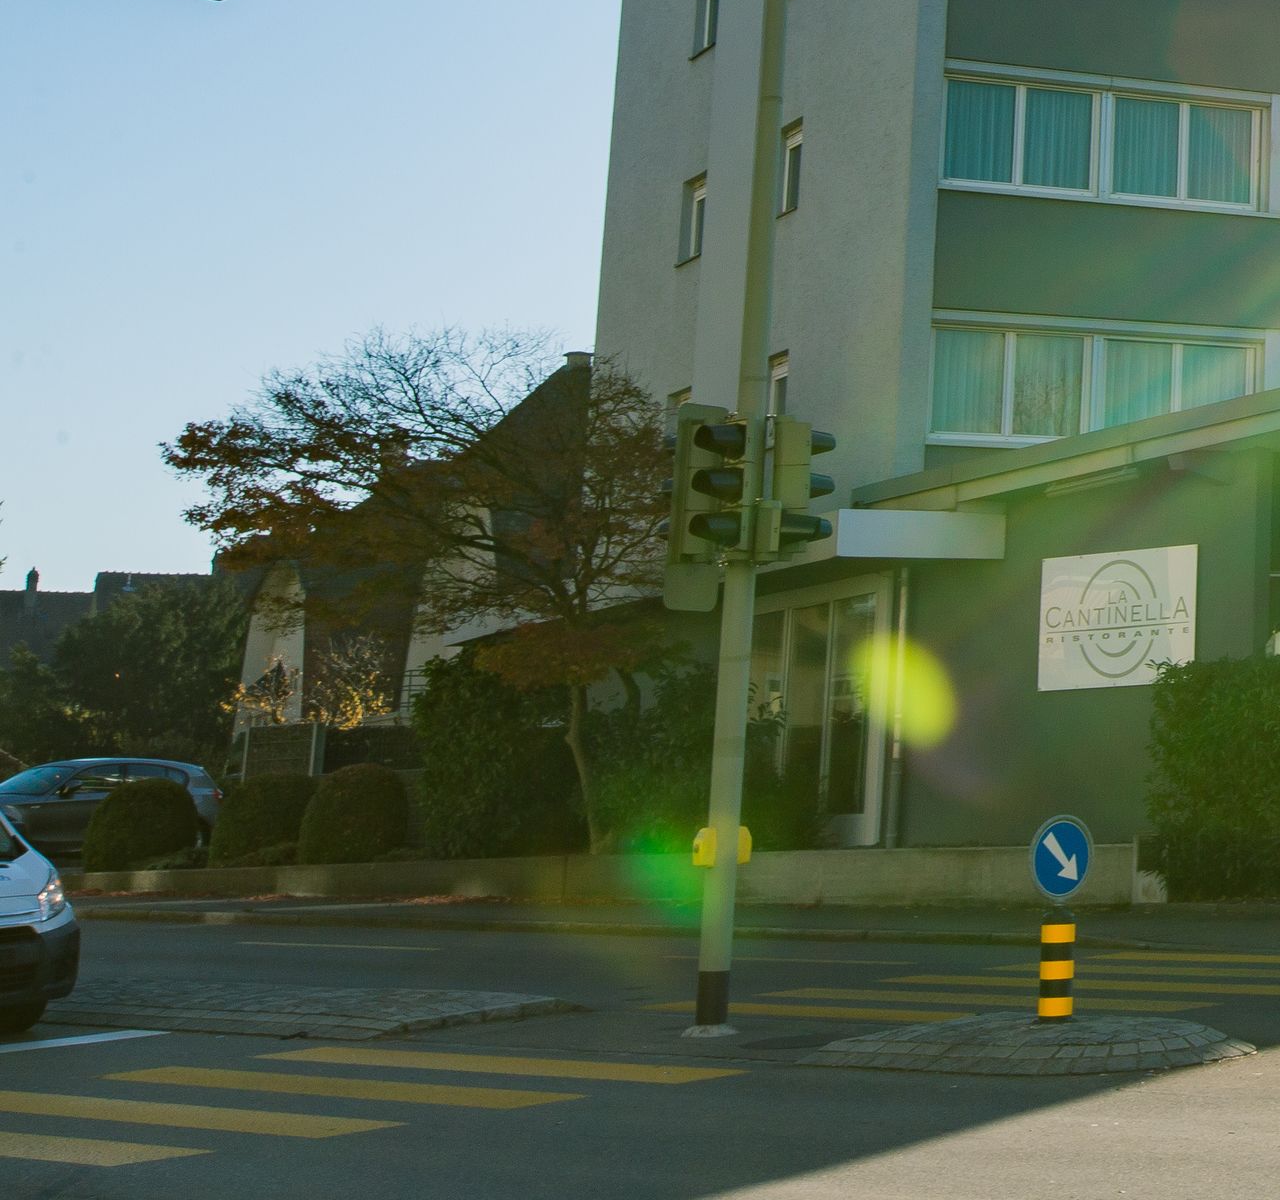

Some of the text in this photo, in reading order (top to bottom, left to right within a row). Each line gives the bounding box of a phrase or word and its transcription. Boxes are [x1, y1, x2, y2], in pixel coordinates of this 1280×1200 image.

[1107, 590, 1128, 605] LA
[1045, 596, 1189, 629] CANTINELLA
[1046, 626, 1190, 644] RISTORANTE
